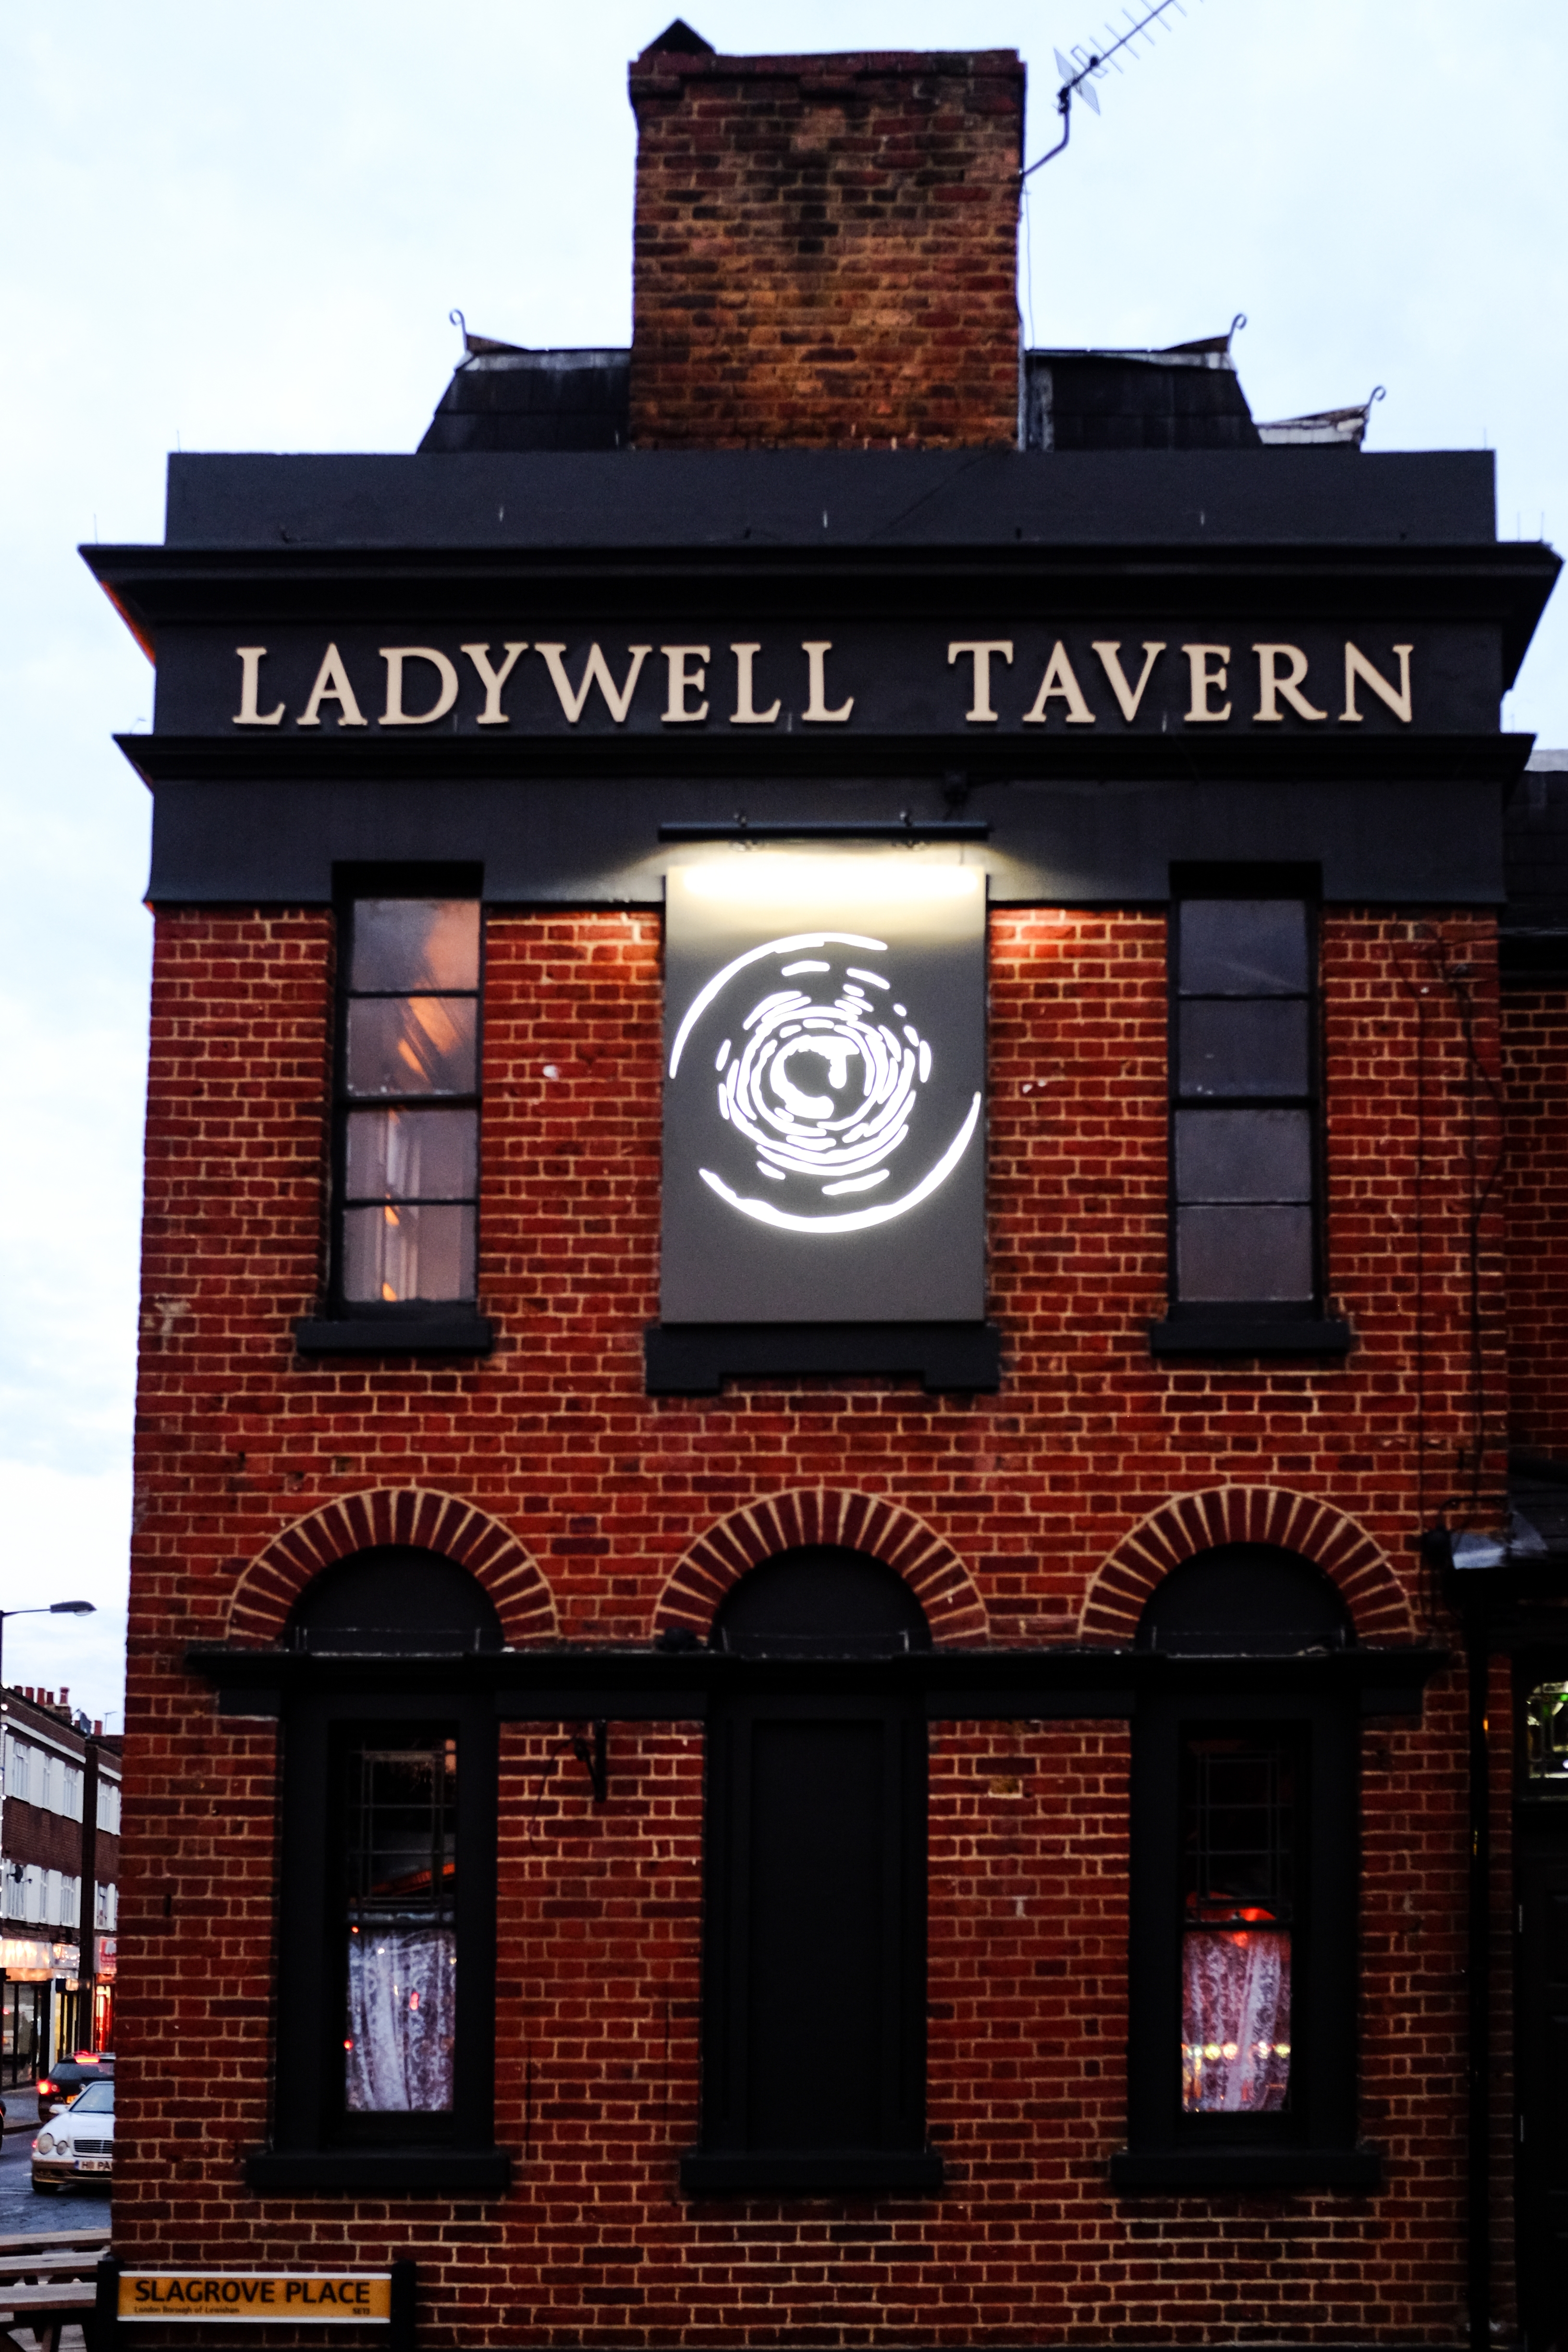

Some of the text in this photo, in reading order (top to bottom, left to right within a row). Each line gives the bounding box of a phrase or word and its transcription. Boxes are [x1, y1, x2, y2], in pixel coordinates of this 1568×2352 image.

[233, 640, 1414, 726] LADYWELL TAVERN
[135, 2280, 370, 2303] SLAGROVE PLACE
